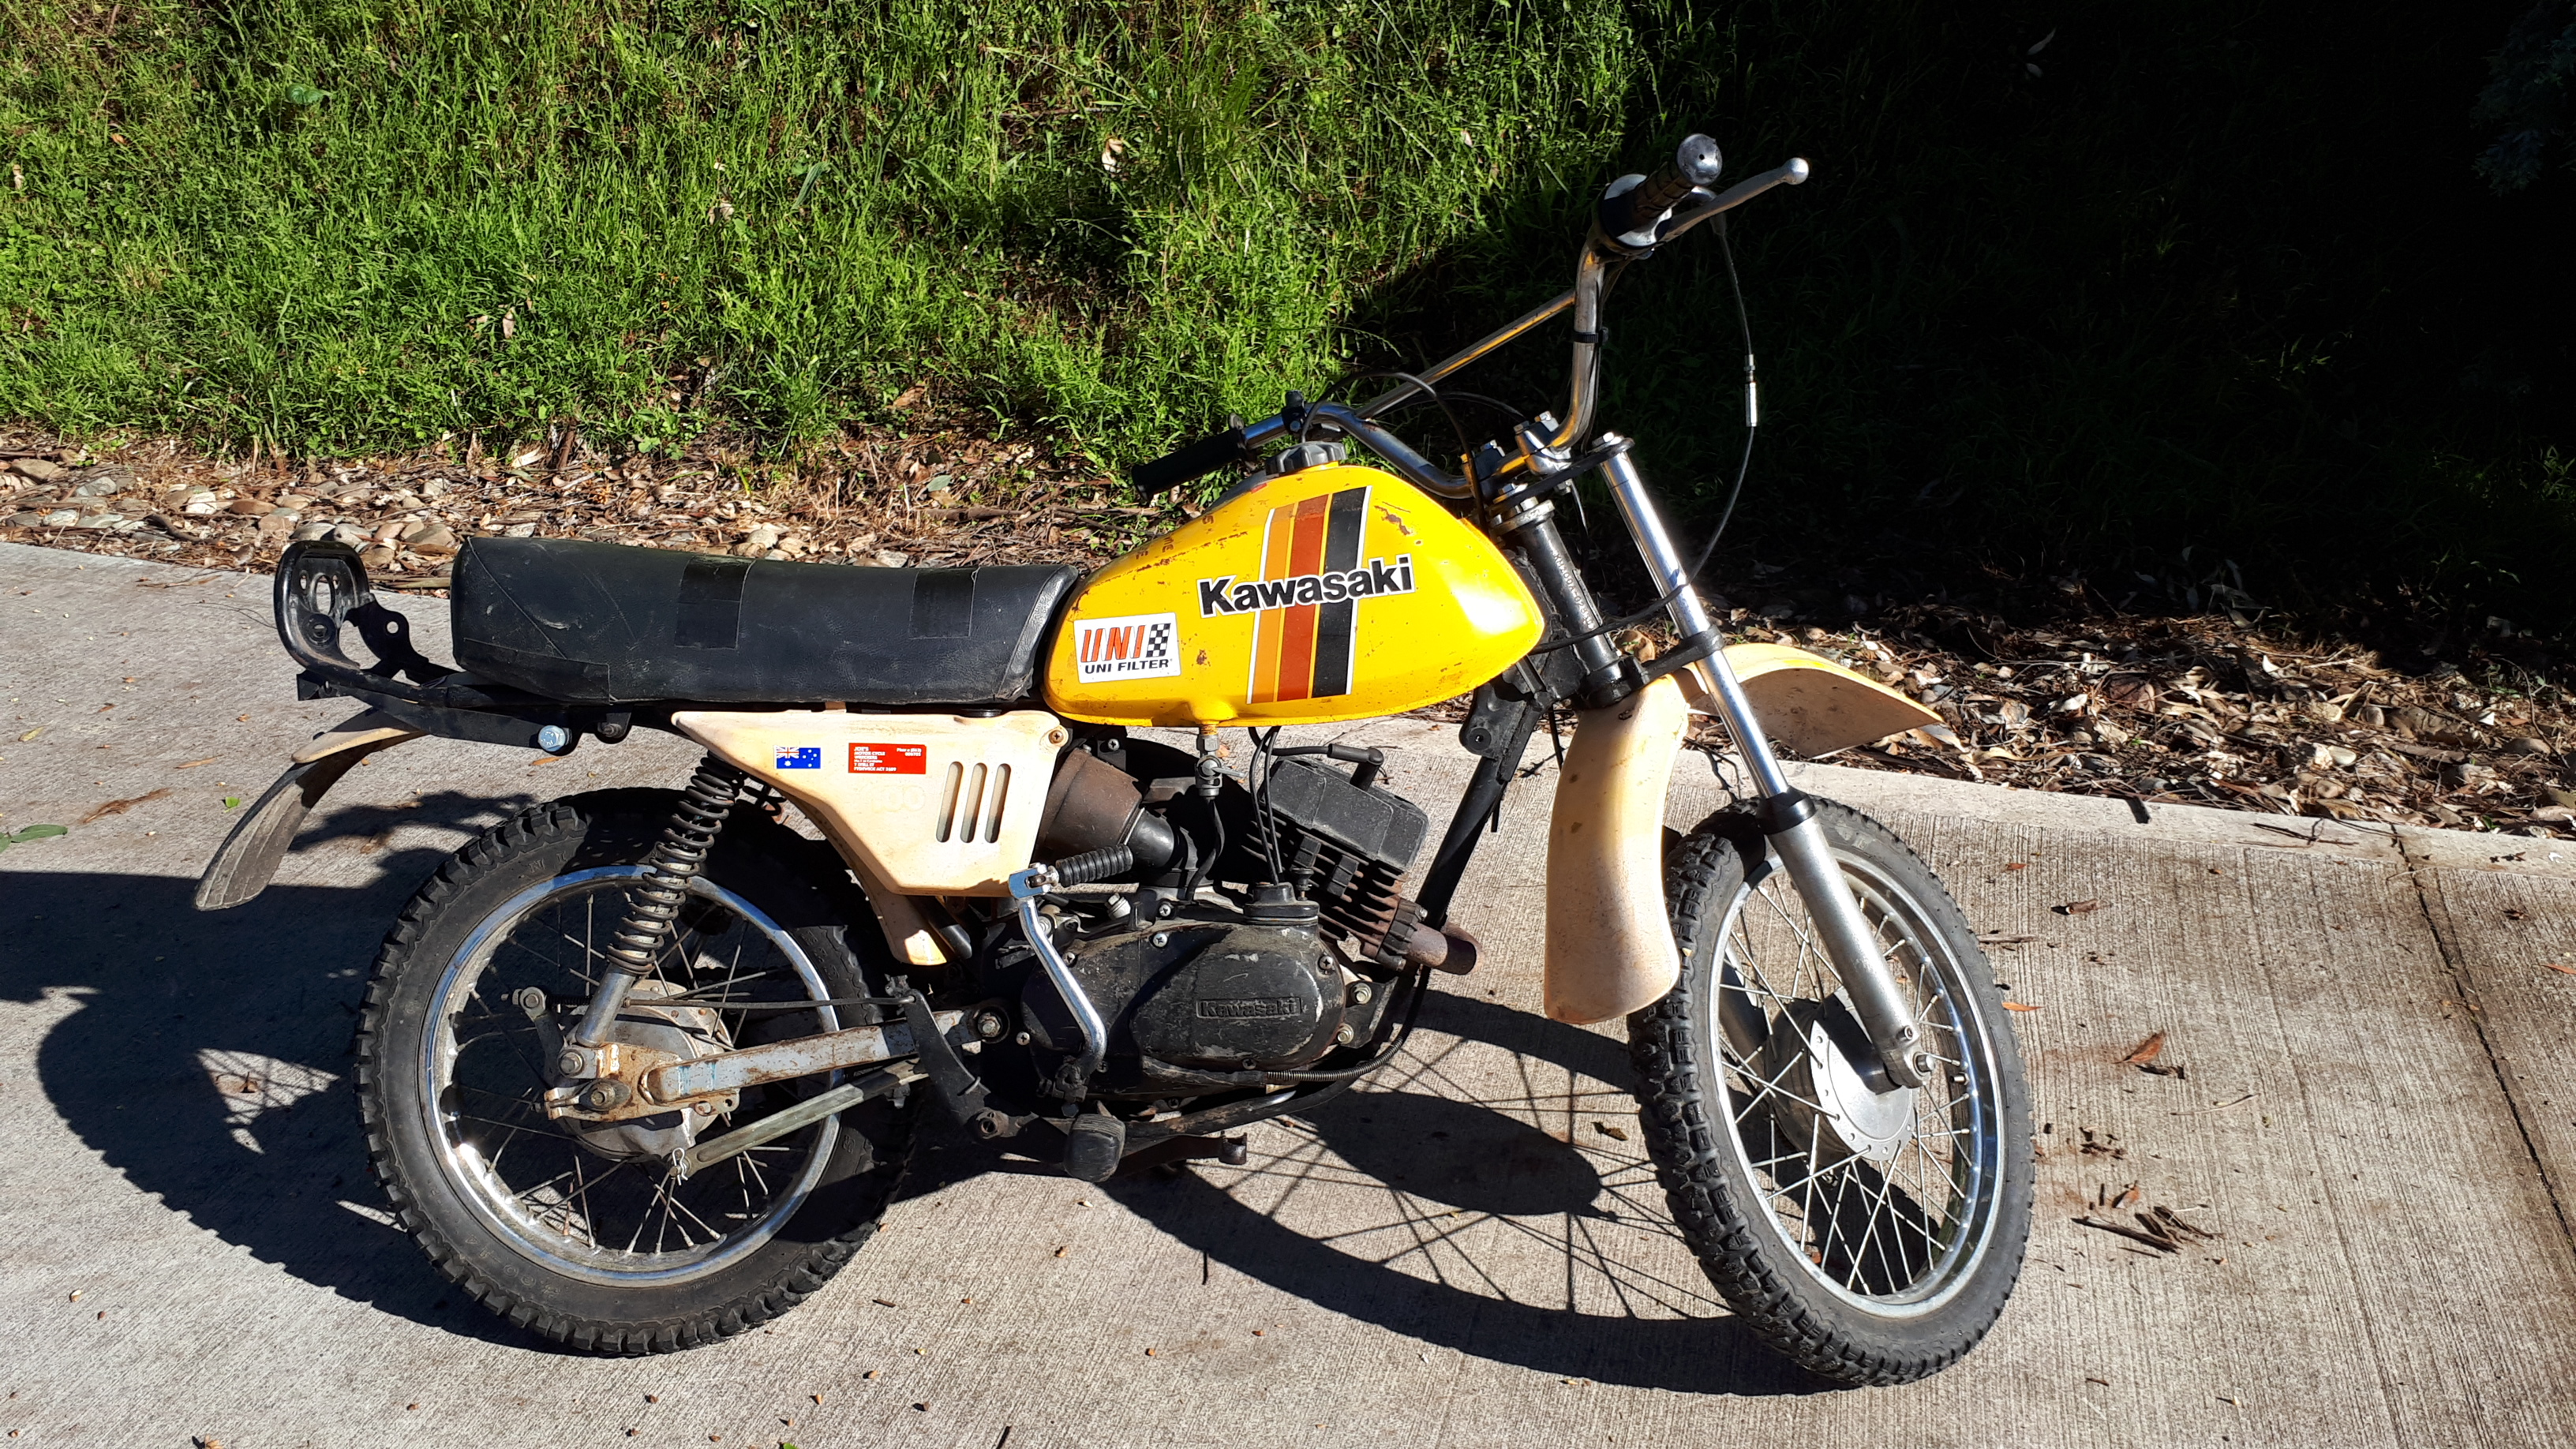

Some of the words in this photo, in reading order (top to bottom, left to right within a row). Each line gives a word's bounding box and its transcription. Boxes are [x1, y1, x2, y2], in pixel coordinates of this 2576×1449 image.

[1199, 556, 1413, 616] Kawasaki
[1084, 663, 1112, 674] UNI
[1117, 659, 1170, 672] FILTER
[1200, 998, 1298, 1017] Kawasaki
